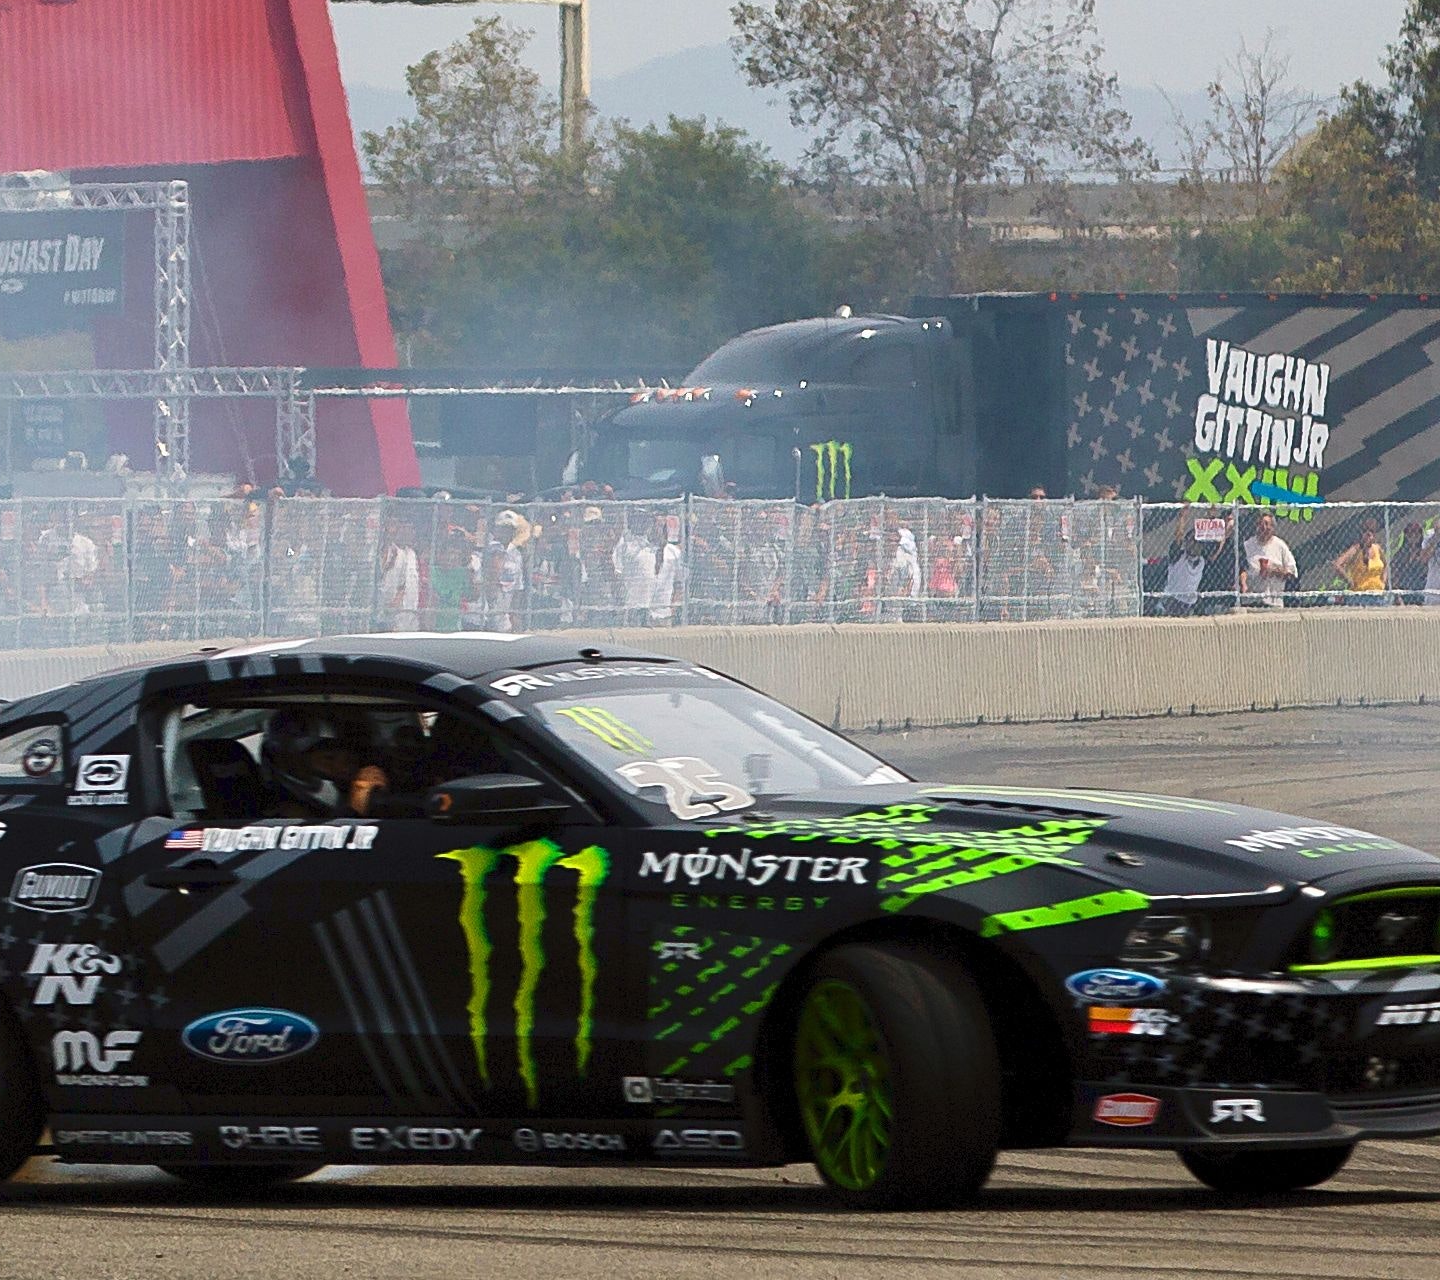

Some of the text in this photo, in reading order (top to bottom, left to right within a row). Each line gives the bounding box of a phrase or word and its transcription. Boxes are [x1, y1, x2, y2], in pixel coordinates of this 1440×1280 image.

[64, 233, 105, 272] DAY
[1206, 338, 1330, 417] VAUGHN
[615, 757, 757, 820] 25
[638, 847, 869, 886] MONSTER
[671, 893, 831, 911] ENERGY
[208, 1016, 294, 1054] Ford
[350, 1127, 483, 1149] EXEDY
[541, 1131, 625, 1151] BOSCH
